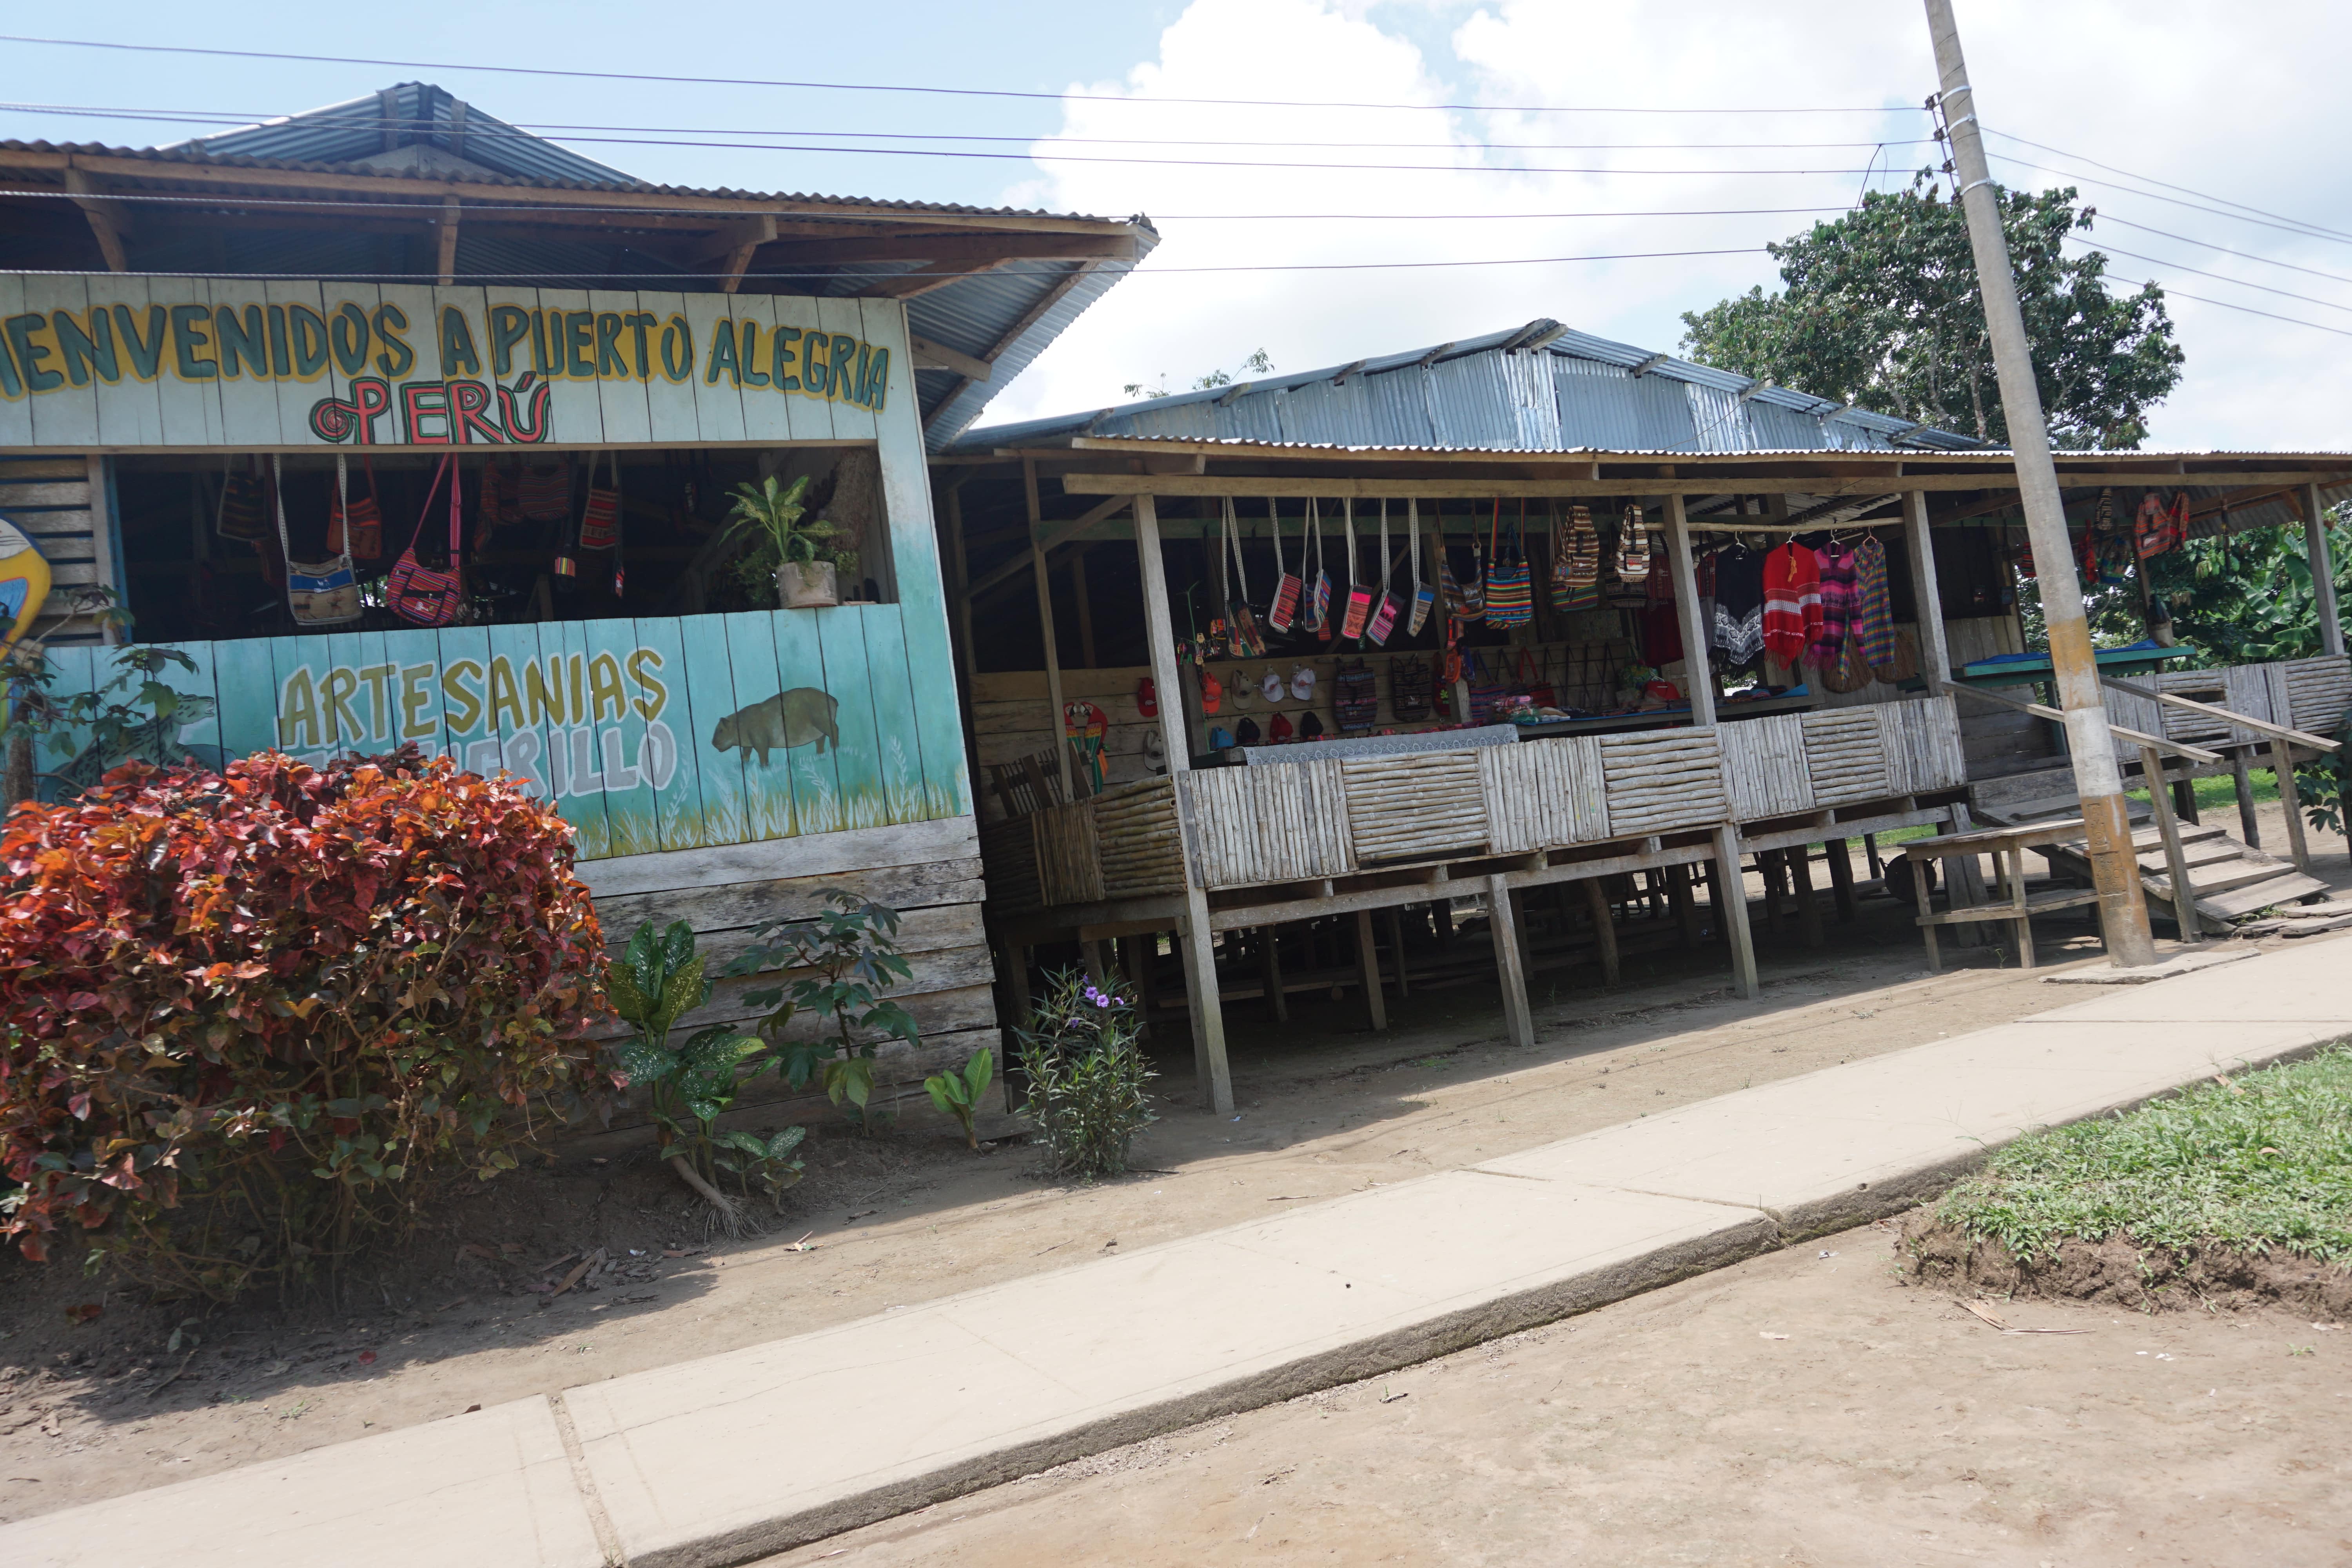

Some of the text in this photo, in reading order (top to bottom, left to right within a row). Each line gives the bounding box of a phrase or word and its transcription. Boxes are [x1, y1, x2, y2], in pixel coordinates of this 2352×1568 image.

[443, 307, 480, 377] A
[492, 307, 693, 381] PUERTO
[708, 320, 890, 410] ALEGRIA
[309, 371, 550, 444] PERÚ
[279, 649, 668, 746] ARTESANIAS
[383, 724, 676, 797] GRILLO
